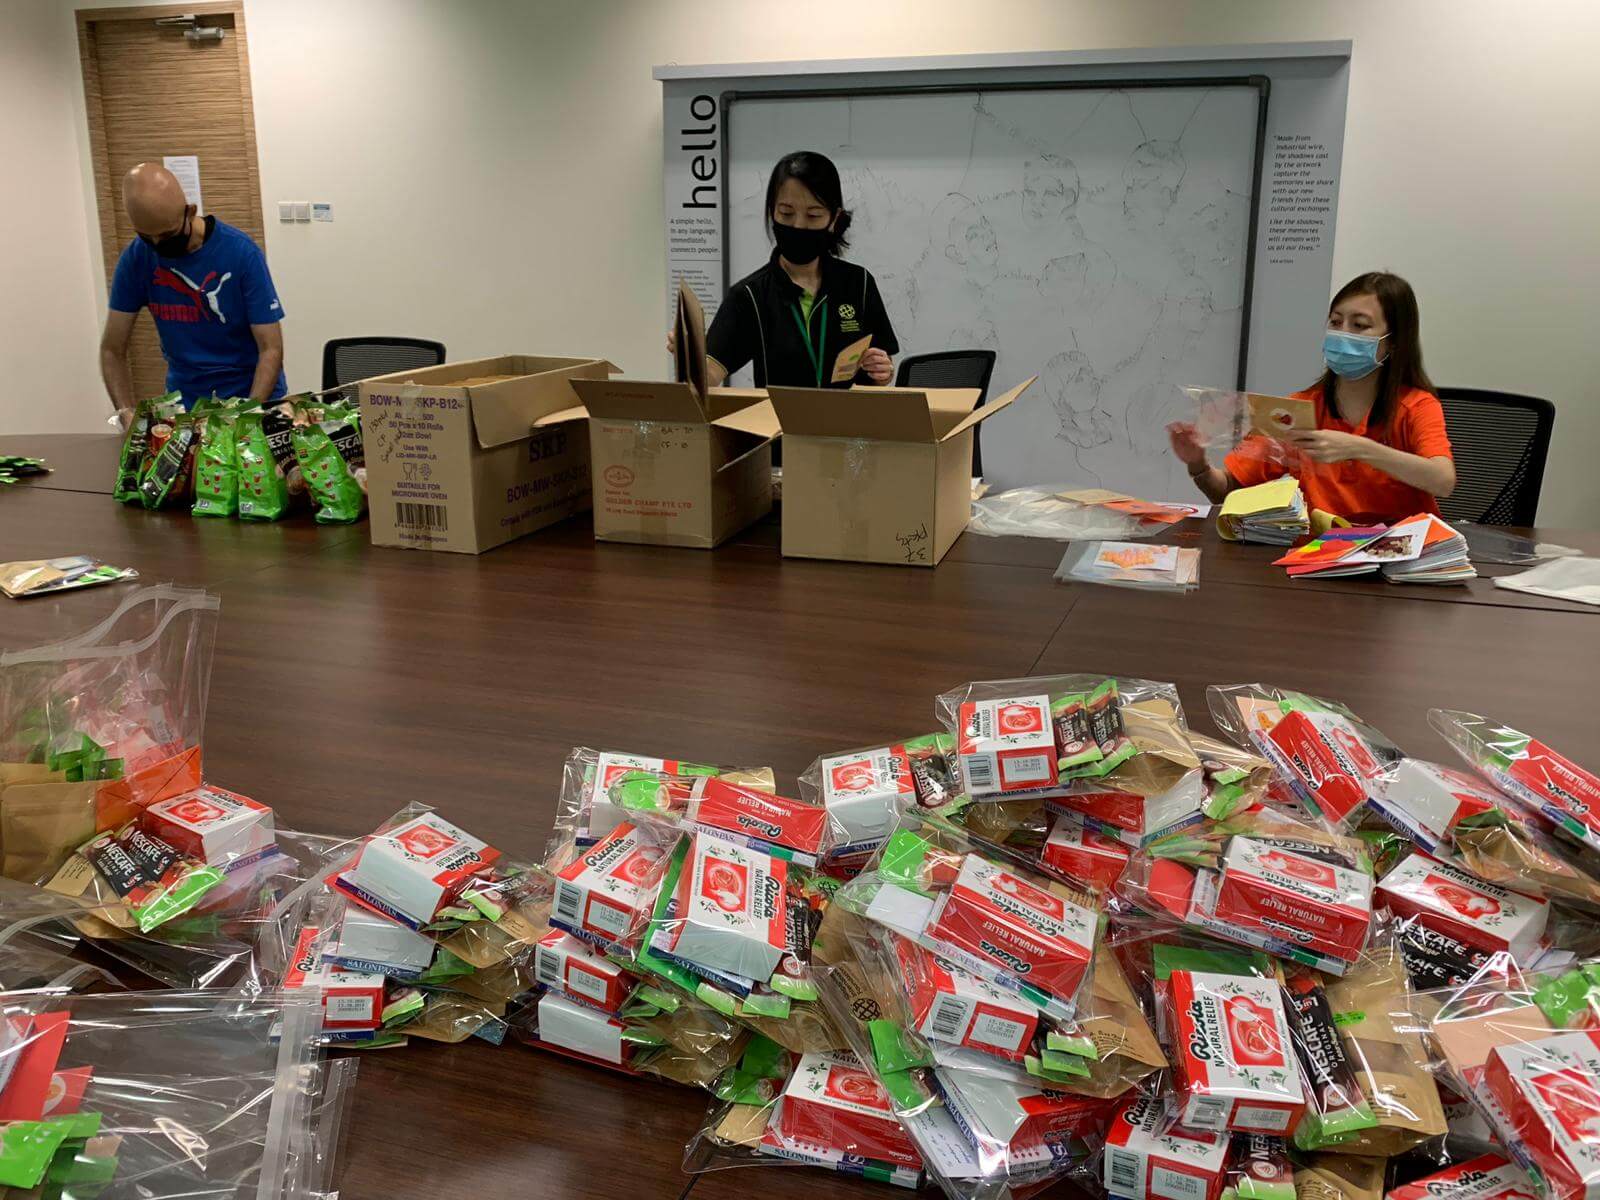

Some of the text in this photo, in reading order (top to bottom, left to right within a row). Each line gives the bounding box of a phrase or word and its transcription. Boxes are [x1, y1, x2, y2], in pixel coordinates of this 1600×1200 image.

[681, 94, 717, 208] hello
[392, 490, 429, 499] MICROWAVE
[678, 501, 692, 509] LTD
[1293, 753, 1320, 791] Ricola
[736, 796, 761, 809] RELIEF
[692, 824, 736, 842] SALONPAS
[736, 813, 783, 838] Ricola
[1383, 811, 1416, 839] SALONPAS
[103, 842, 136, 877] NESCAFE
[128, 829, 162, 862] NESCAFE
[585, 837, 626, 867] Ricola
[593, 838, 636, 873] NATURAL RELIEF
[753, 868, 763, 919] NATURAL RELIEF
[1432, 865, 1476, 887] NATURAL
[1475, 882, 1510, 898] RELIEF
[356, 889, 401, 919] SALONPAS
[764, 875, 781, 919] Ricola
[988, 890, 1019, 912] RELIEF
[1261, 897, 1327, 924] NATURAL RELIEF
[992, 897, 1058, 937] Ricola
[1018, 904, 1065, 933] NATURAL
[1202, 920, 1249, 940] SALONPAS
[1260, 916, 1315, 943] Ricola
[981, 920, 1047, 957] NATURAL RELIEF
[347, 959, 401, 975] SALONPAS
[674, 956, 723, 985] SALONPAS
[936, 942, 983, 973] SALONPAS
[980, 940, 1032, 974] Ricola
[1187, 999, 1212, 1061] Ricola
[1203, 995, 1226, 1068] NATURAL RELIEF
[1318, 1021, 1339, 1069] ORIGINAL
[1301, 1012, 1335, 1084] NESCAFE
[773, 1149, 822, 1164] SALONPAS
